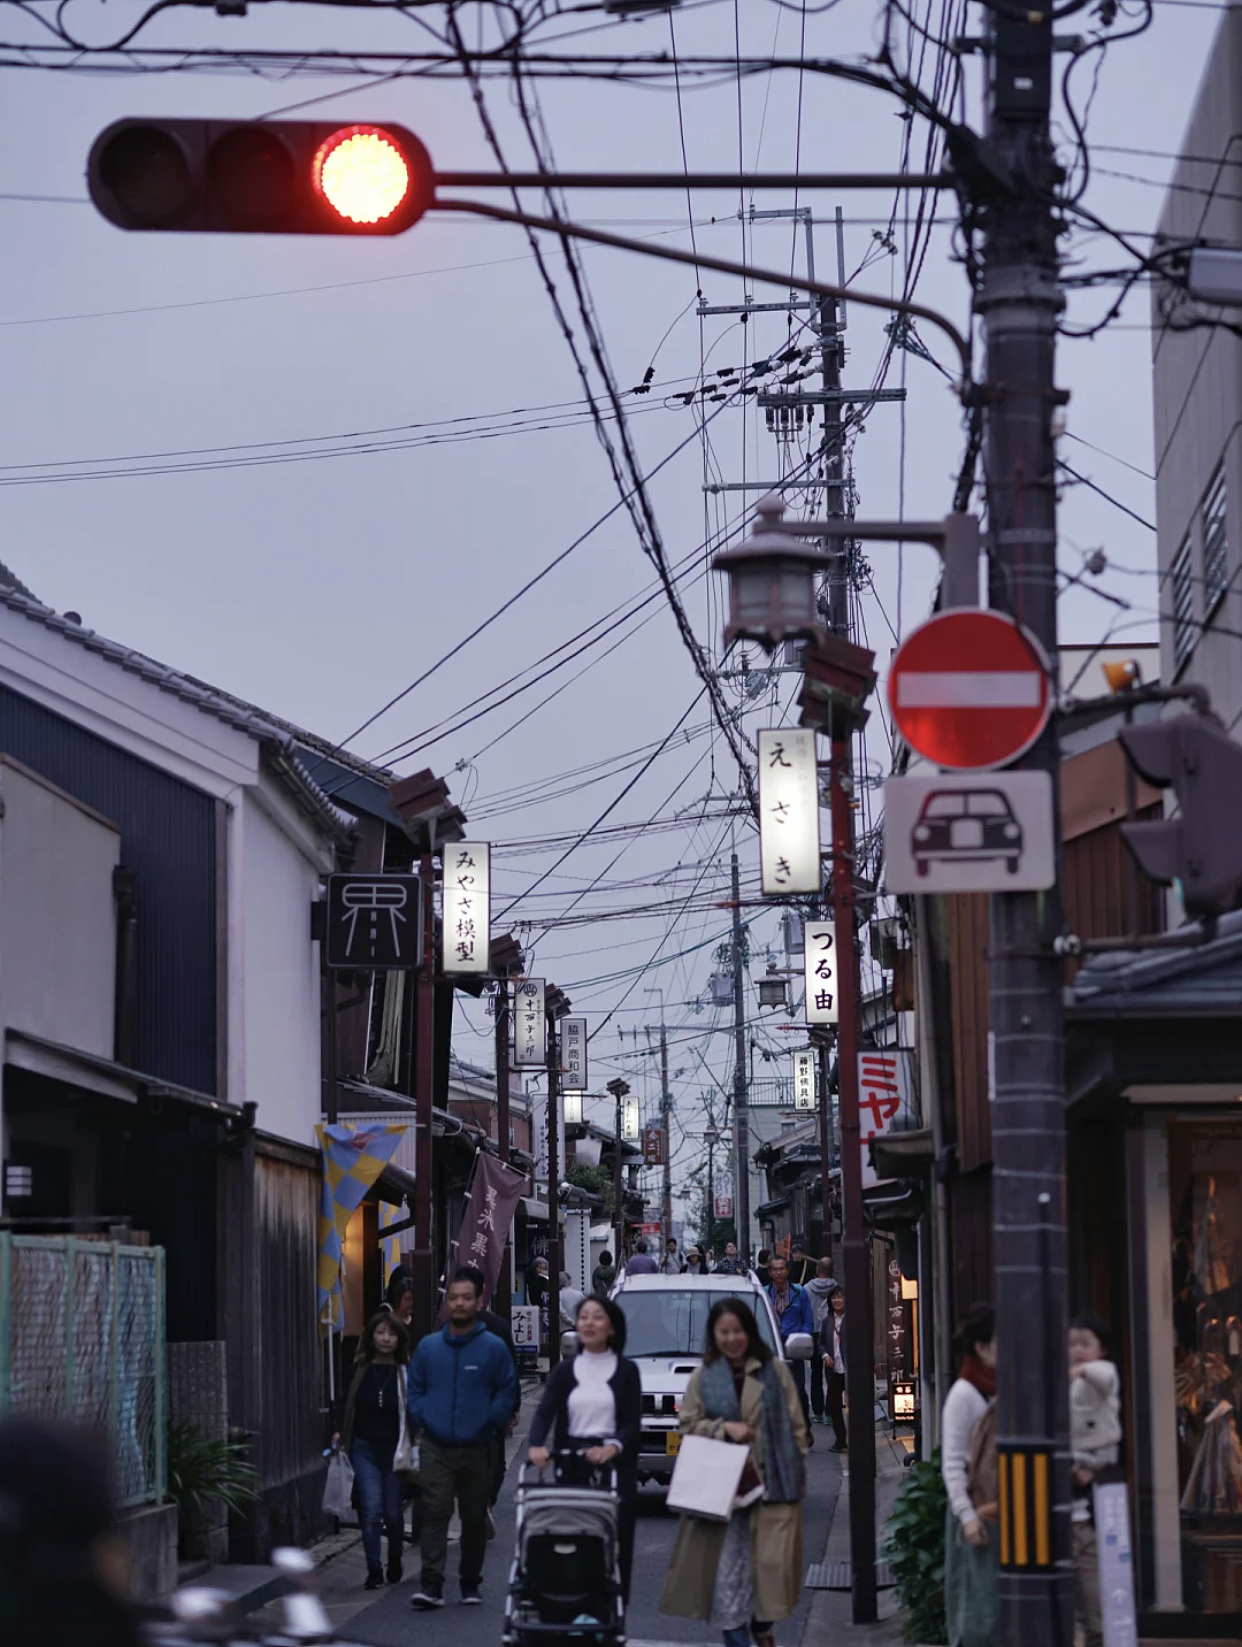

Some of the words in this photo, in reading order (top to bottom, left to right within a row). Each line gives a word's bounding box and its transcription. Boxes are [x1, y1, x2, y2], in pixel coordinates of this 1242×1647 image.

[769, 742, 792, 884] えさき
[456, 851, 477, 962] みやさ模型
[812, 932, 833, 1011] つる由
[512, 1311, 527, 1345] みよし
